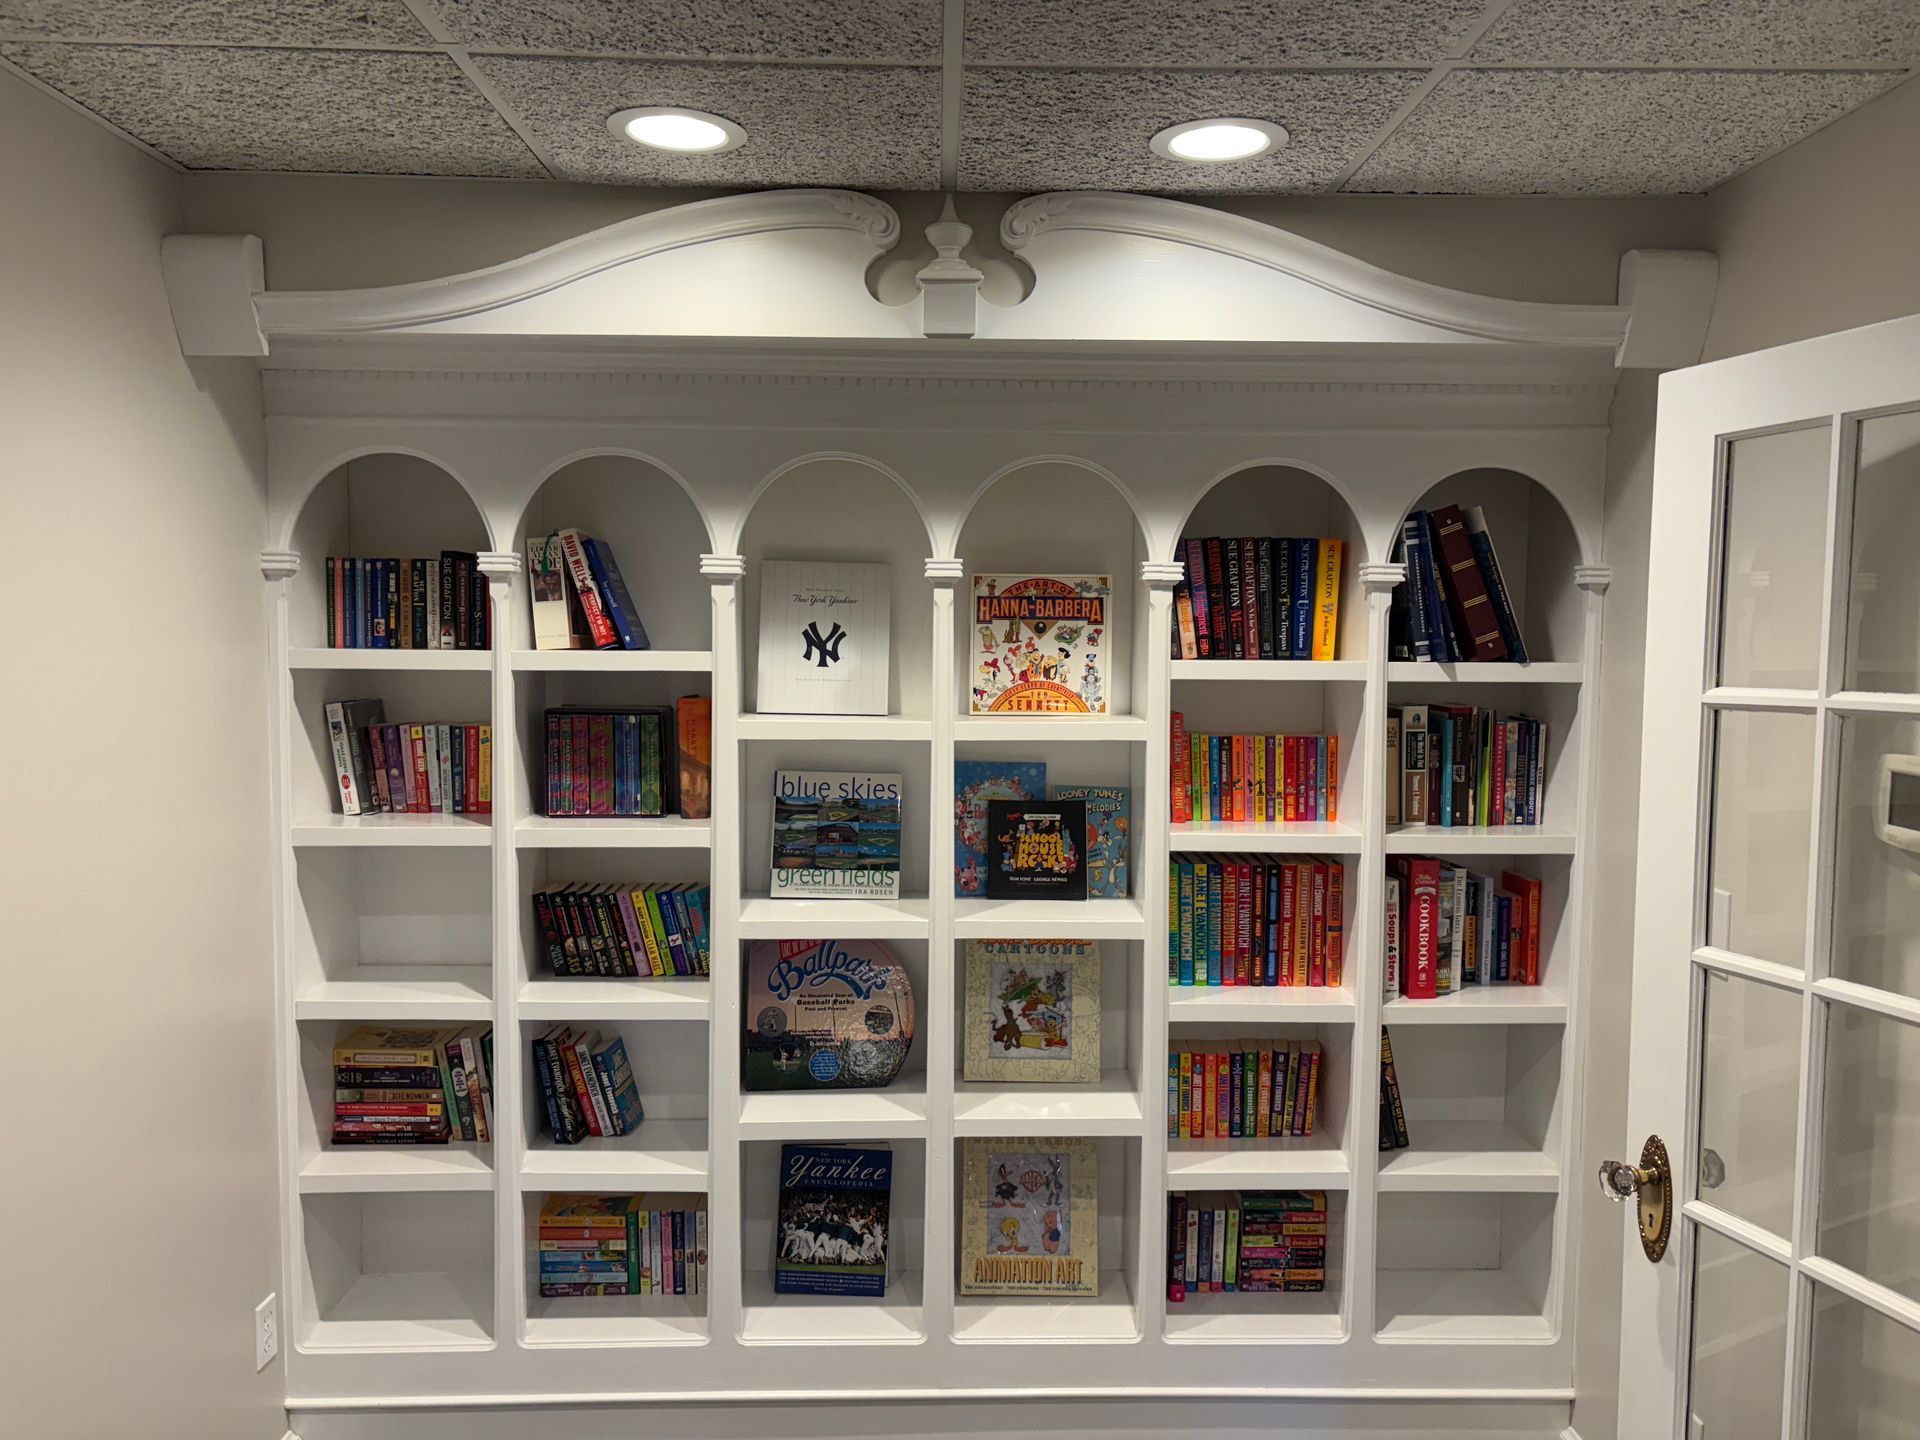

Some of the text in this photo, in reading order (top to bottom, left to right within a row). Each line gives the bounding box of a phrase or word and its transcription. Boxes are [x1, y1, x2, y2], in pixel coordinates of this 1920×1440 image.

[564, 534, 589, 586] DAVID WELLS
[1280, 540, 1289, 556] SUE
[1300, 543, 1309, 559] SUE
[1259, 541, 1271, 592] Sue Grafton
[1280, 557, 1289, 595] GRAFTON
[1300, 559, 1309, 597] GRAFTON
[443, 558, 452, 620] SUE GRAFTON
[1007, 580, 1075, 597] THE ART OF
[1228, 540, 1242, 622] SUE GRAFTON M
[604, 588, 617, 608] yourself
[792, 594, 809, 603] New
[809, 594, 828, 607] York
[978, 597, 1102, 622] HANNA-BARBERA
[1279, 594, 1290, 606] T
[1296, 599, 1309, 610] U
[588, 591, 607, 636] PERFECT I'M NOT
[1281, 612, 1289, 620] for
[1279, 620, 1289, 651] Trespass
[1298, 622, 1306, 649] Undertow
[1007, 699, 1069, 711] SENNETT
[1030, 691, 1049, 699] TED
[1174, 719, 1182, 736] MARY
[1417, 733, 1425, 742] The
[350, 732, 362, 776] THIRD GIRL
[415, 740, 425, 772] CRIME SEEN
[781, 775, 899, 800] blue skies
[1174, 768, 1182, 785] LOCO
[1495, 767, 1503, 810] VACATIONS
[1528, 760, 1537, 815] YANKEE DUGOUT
[1057, 789, 1124, 802] LOONEY TUNES
[1175, 788, 1183, 810] MOTIVE
[1018, 842, 1064, 855] HOUSE
[1019, 832, 1063, 843] SCHOOL
[777, 863, 895, 888] green fields
[1283, 870, 1293, 887] Janet
[1314, 873, 1323, 890] JANET
[1209, 873, 1221, 951] JANET EVANOVICH
[1223, 873, 1235, 951] JANET EVANOVICH
[1238, 878, 1251, 948] JANET EVANOVICH
[1283, 888, 1293, 919] Evanovich
[1314, 889, 1324, 916] EVANOVICH
[1169, 874, 1179, 979] JANET EVANOVICH HARD EIGHT
[1181, 872, 1193, 961] JANET EVANOVICH
[1195, 873, 1207, 961] JANET EVANOVICH
[1299, 868, 1309, 976] Janet Evanovich TAKEDOWN TWENTY
[640, 920, 649, 940] DAHEIM
[1282, 922, 1290, 950] Notorious
[1418, 895, 1431, 970] COOKBOOK
[1467, 917, 1475, 968] SWITZERLAND
[645, 939, 656, 956] CLAM
[984, 944, 1085, 956] CARTOONS
[1387, 913, 1397, 982] Soups & Stews
[650, 956, 661, 972] WAKE
[1282, 951, 1290, 976] Nineteen
[1381, 1034, 1393, 1064] TRUMP
[600, 1071, 618, 1114] Janet Evanovich
[1391, 1085, 1399, 1098] HOW
[1394, 1099, 1400, 1107] TO
[1398, 1118, 1406, 1132] RICH
[785, 1155, 887, 1187] Yankee
[804, 1179, 875, 1189] ENCYCLOPEDIA
[974, 1257, 1084, 1284] ANIMATION ART
